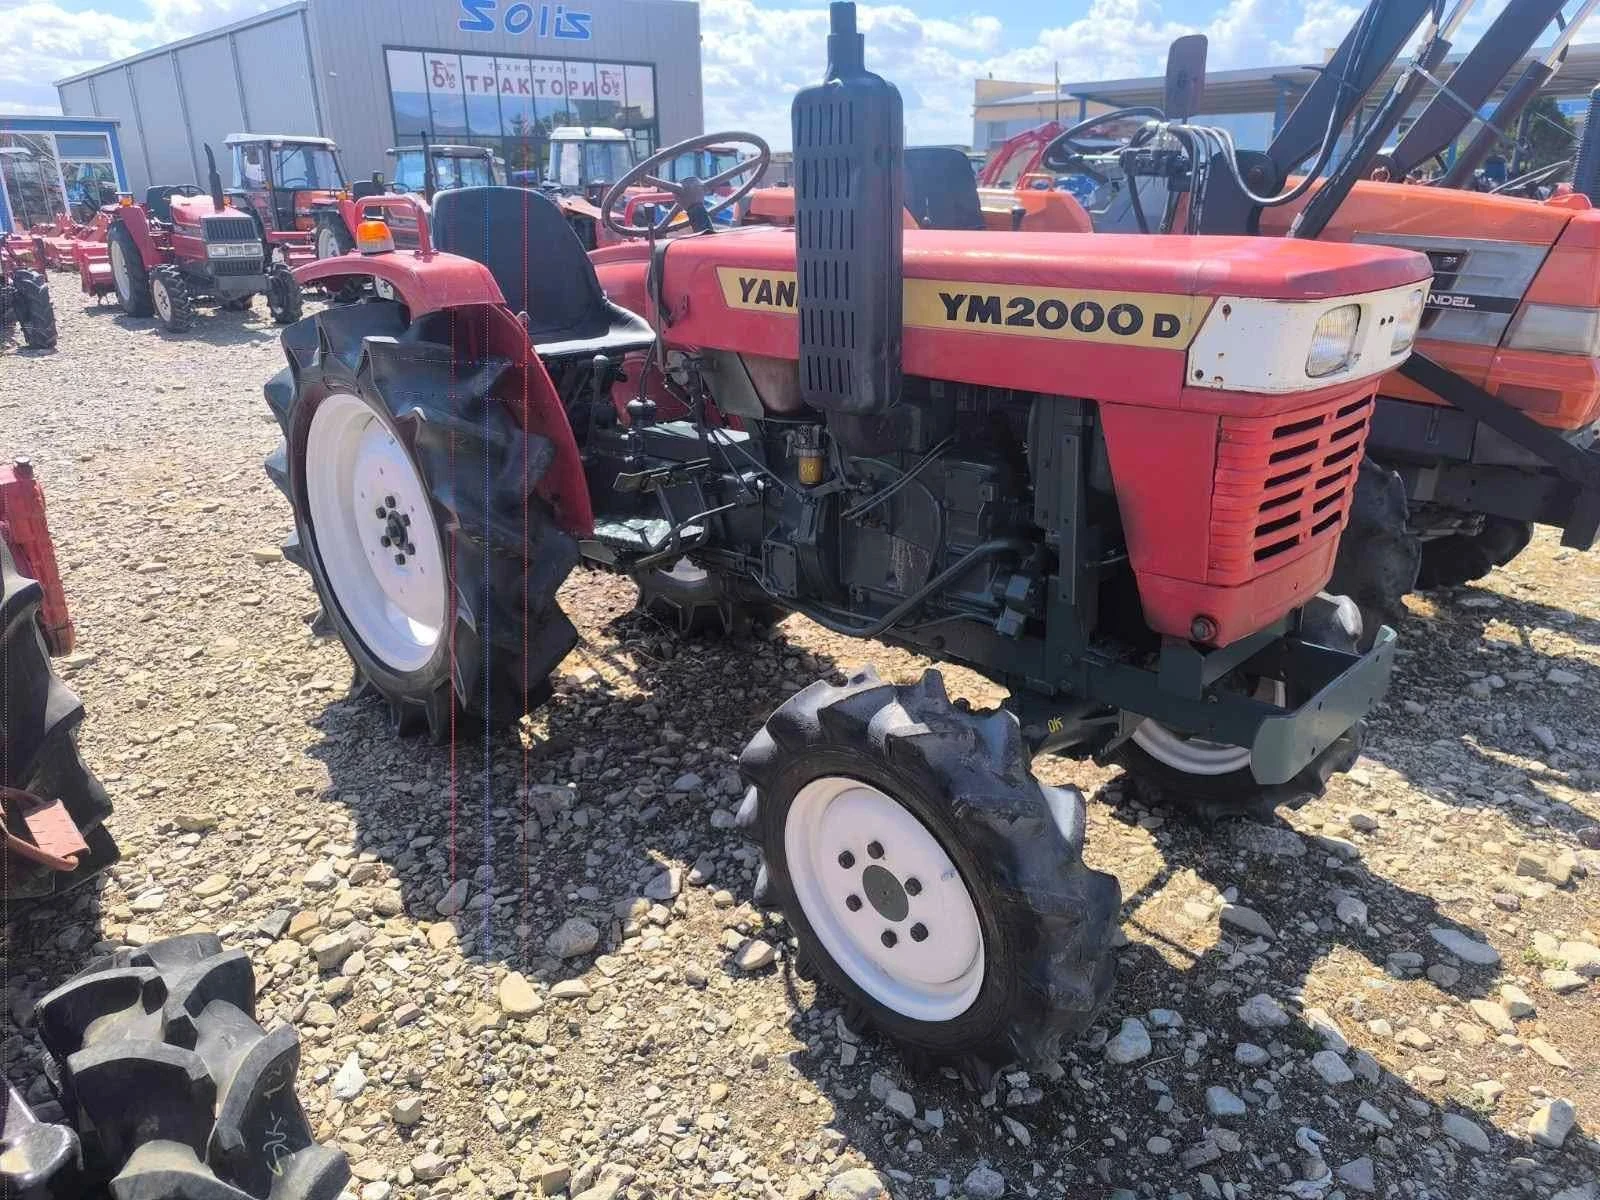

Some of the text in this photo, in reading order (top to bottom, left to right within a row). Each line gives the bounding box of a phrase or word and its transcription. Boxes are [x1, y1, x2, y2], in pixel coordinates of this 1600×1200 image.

[465, 74, 596, 97] ТРАКТОРИ
[739, 276, 799, 308] YAN
[938, 292, 1181, 339] YM2000 D
[1047, 716, 1064, 733] OK
